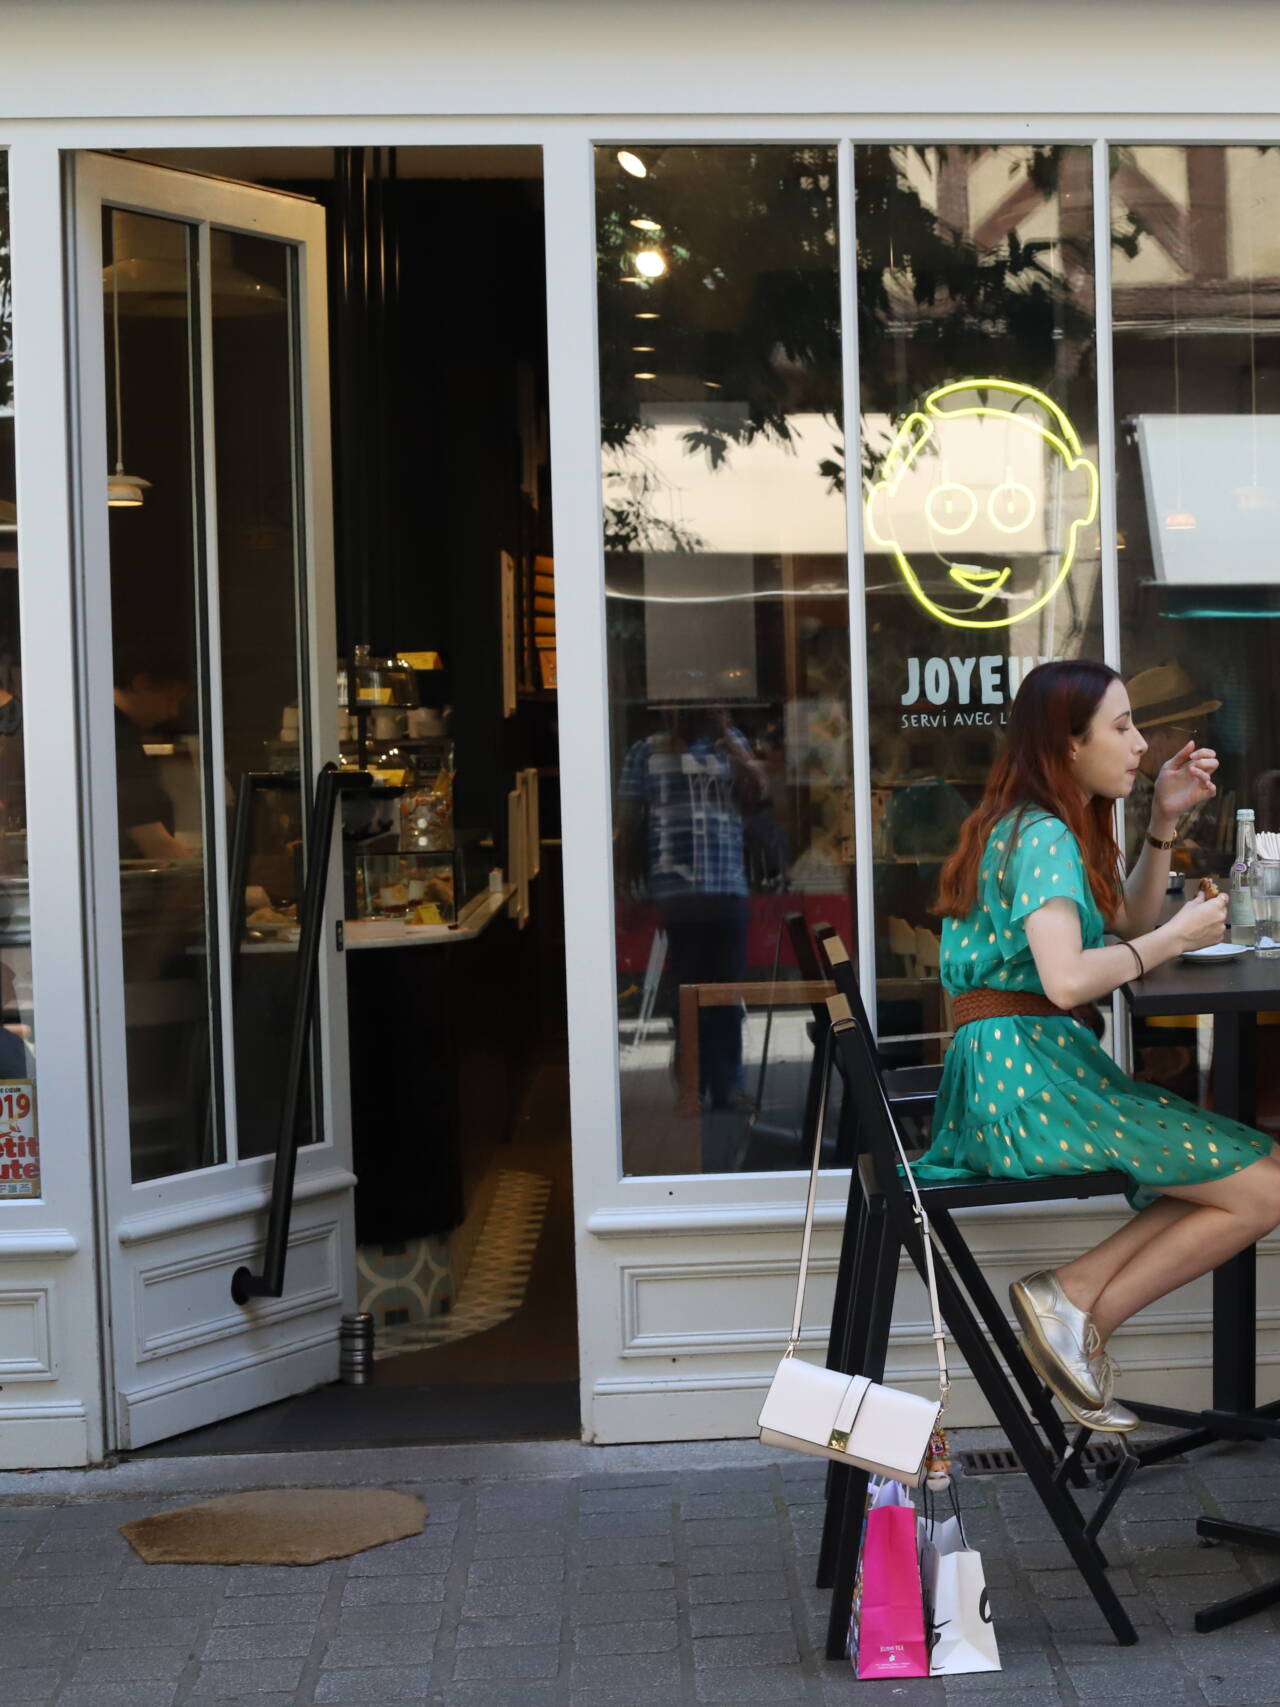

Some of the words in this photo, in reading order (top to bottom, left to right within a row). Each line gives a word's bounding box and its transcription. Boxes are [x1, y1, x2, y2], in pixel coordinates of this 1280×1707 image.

[901, 655, 1063, 706] JOYEU
[953, 711, 993, 726] AVEC
[0, 1093, 31, 1119] 19
